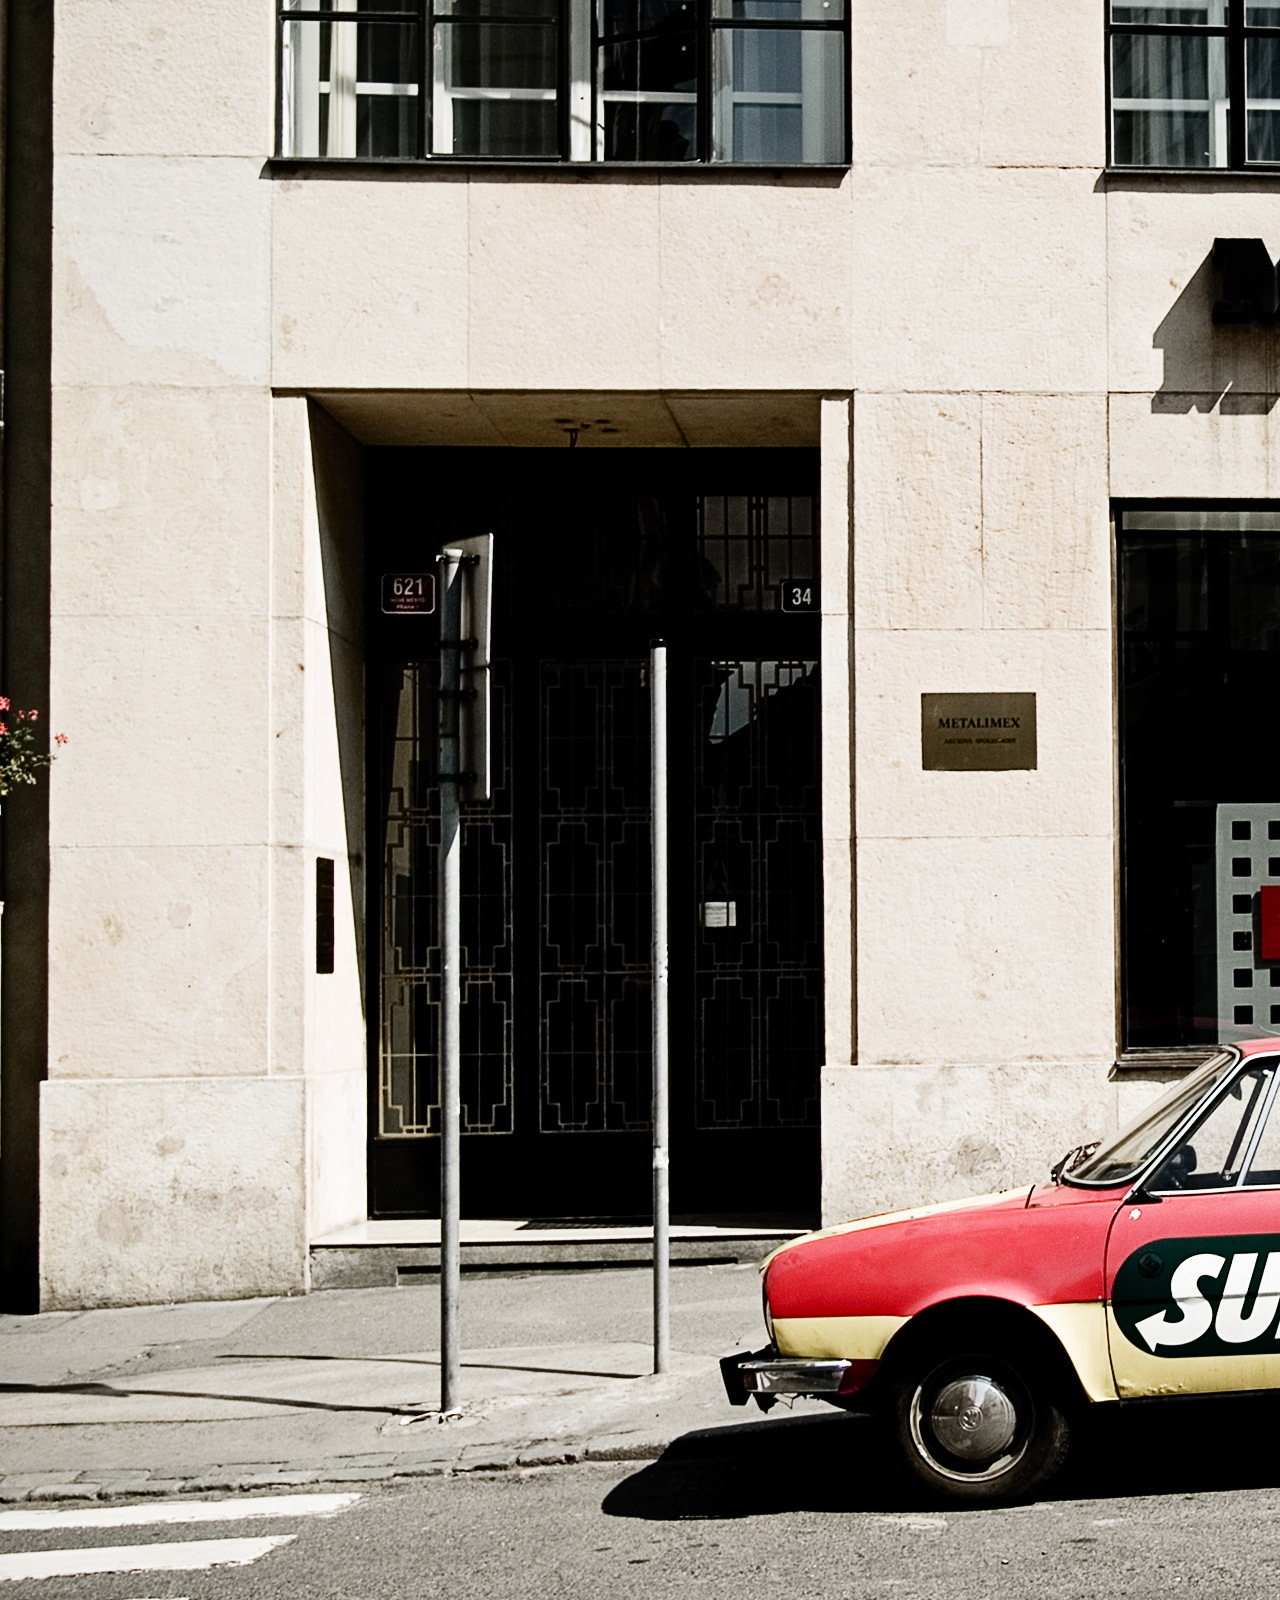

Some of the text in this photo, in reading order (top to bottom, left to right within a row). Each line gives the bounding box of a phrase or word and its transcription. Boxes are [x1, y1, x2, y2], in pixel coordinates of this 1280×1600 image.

[393, 577, 422, 595] 621
[792, 587, 811, 605] 34
[939, 717, 1020, 729] METALIMEX
